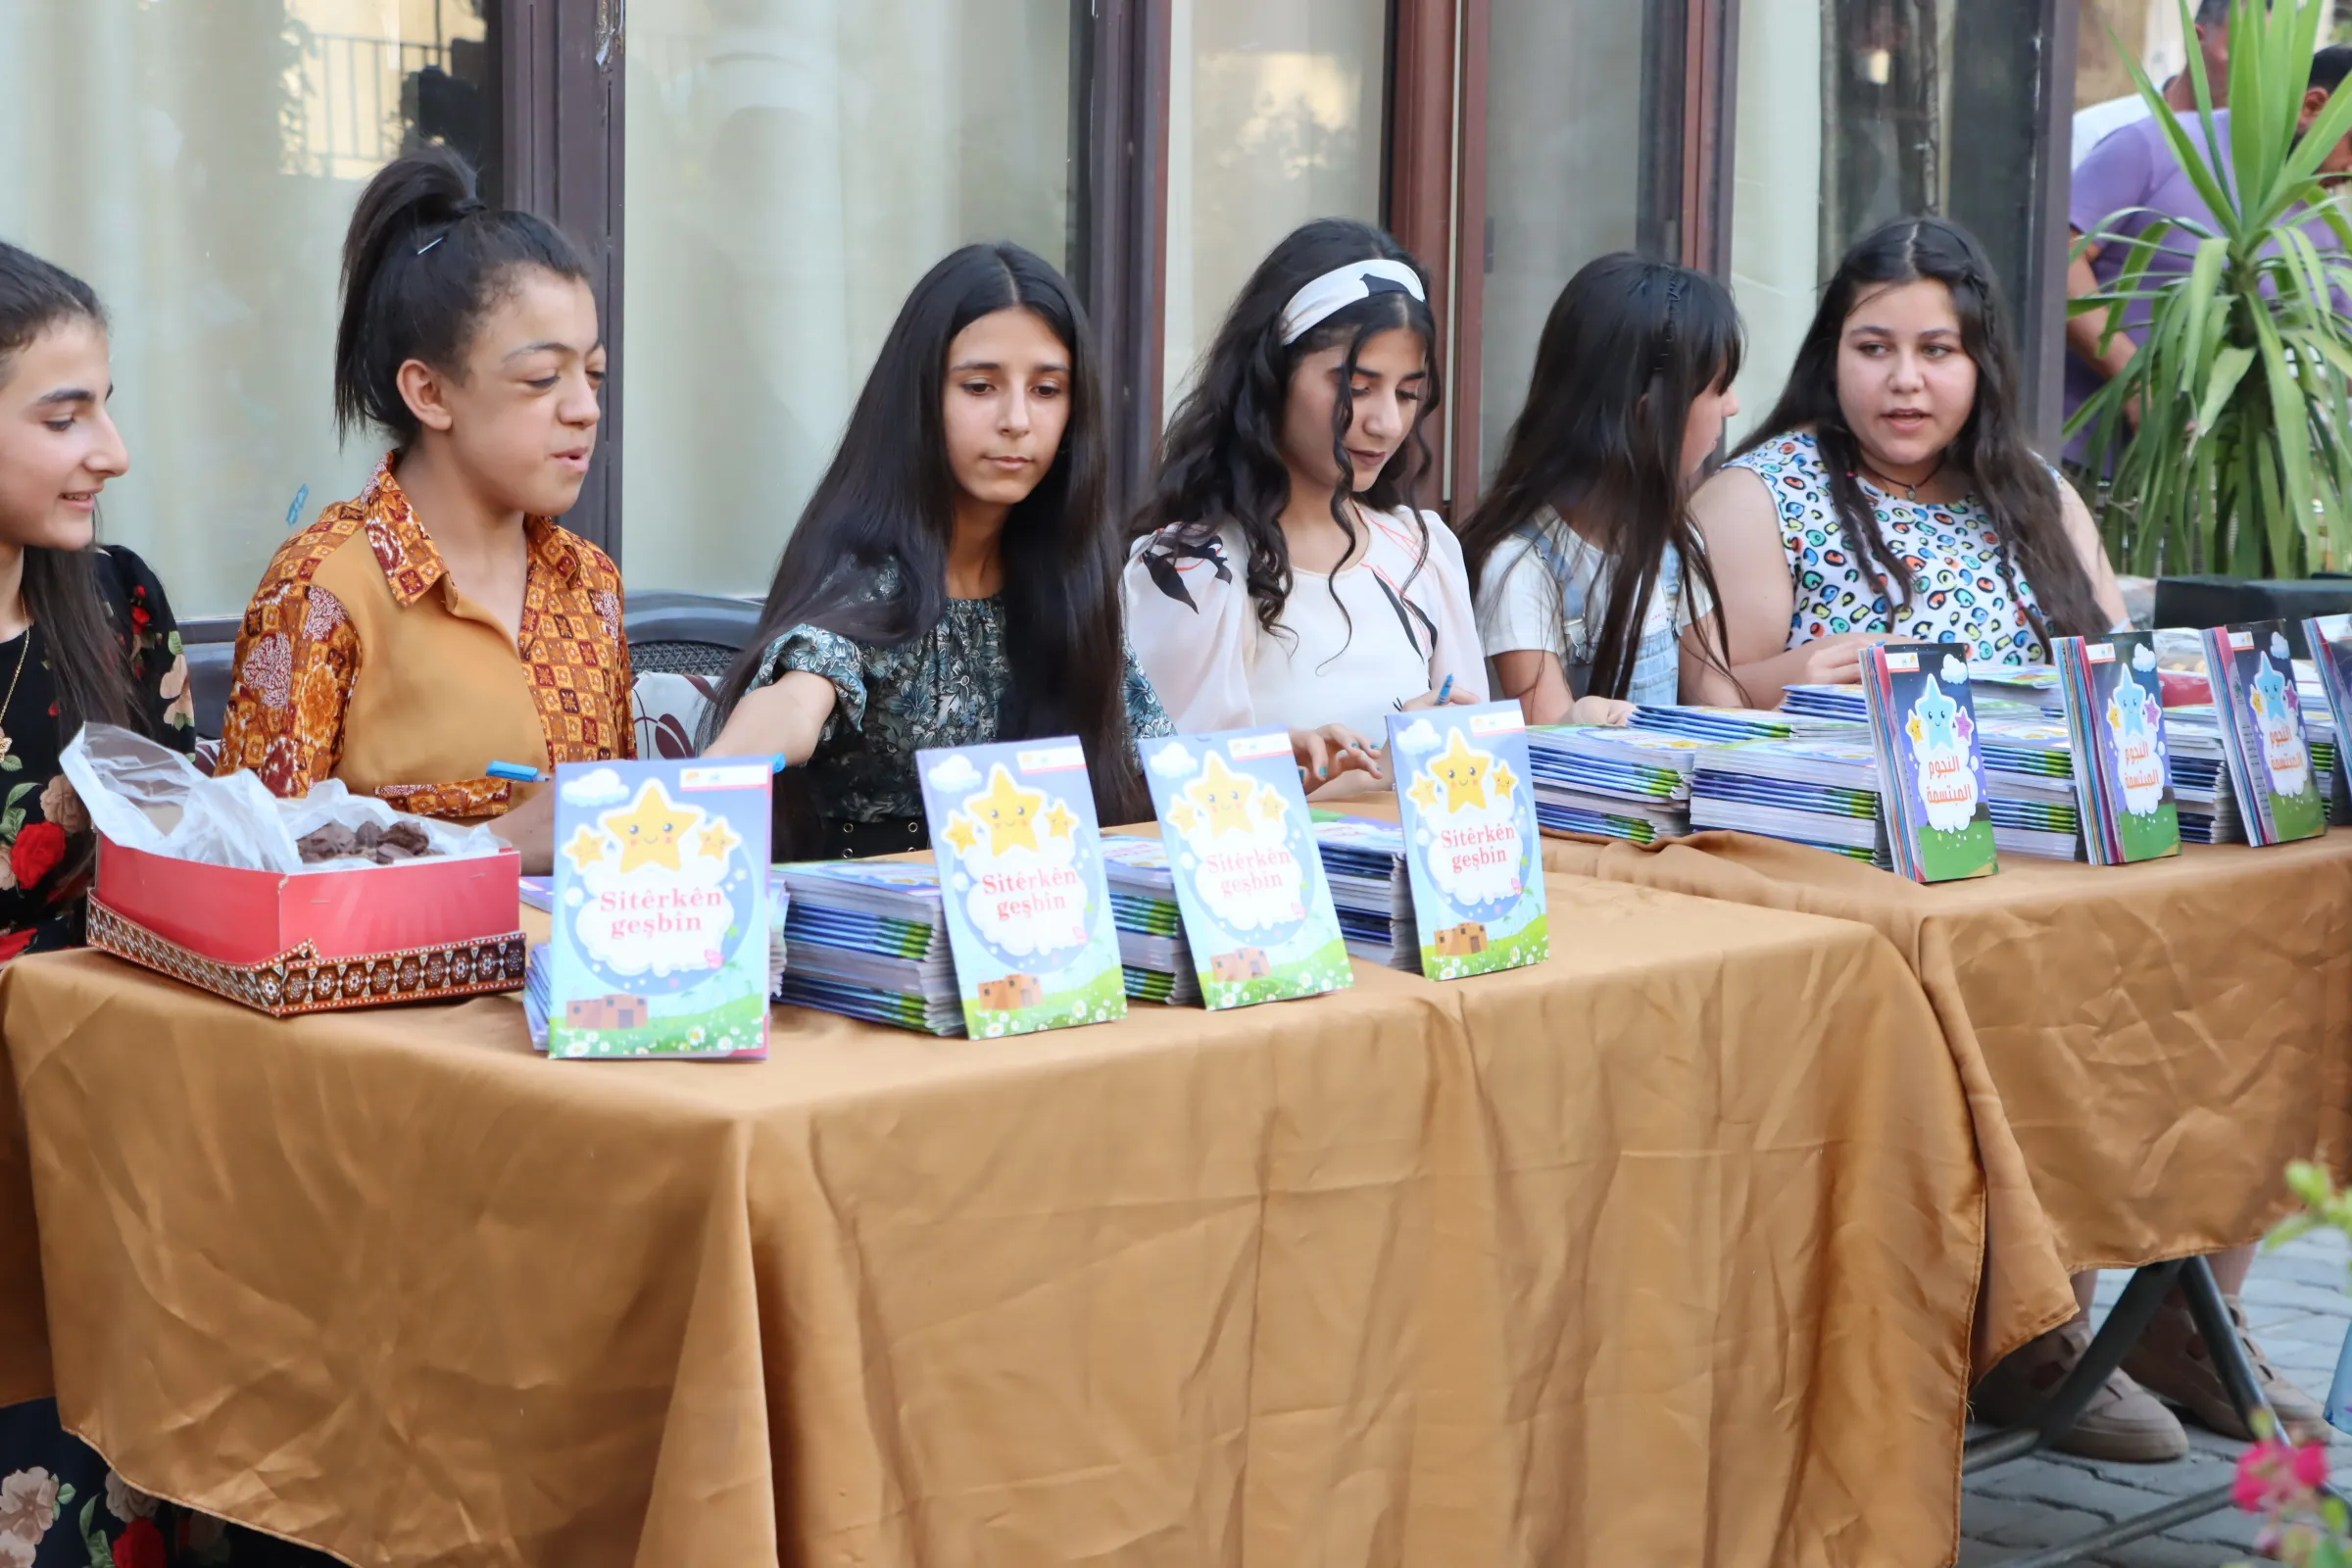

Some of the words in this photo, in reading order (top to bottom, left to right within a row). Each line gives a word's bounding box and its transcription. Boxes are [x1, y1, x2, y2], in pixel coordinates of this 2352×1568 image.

[1929, 756, 1960, 780] النجوم
[1927, 784, 1973, 806] المبتسمة
[1441, 822, 1516, 849] Sitêrkên
[600, 886, 723, 912] Sitêrkên
